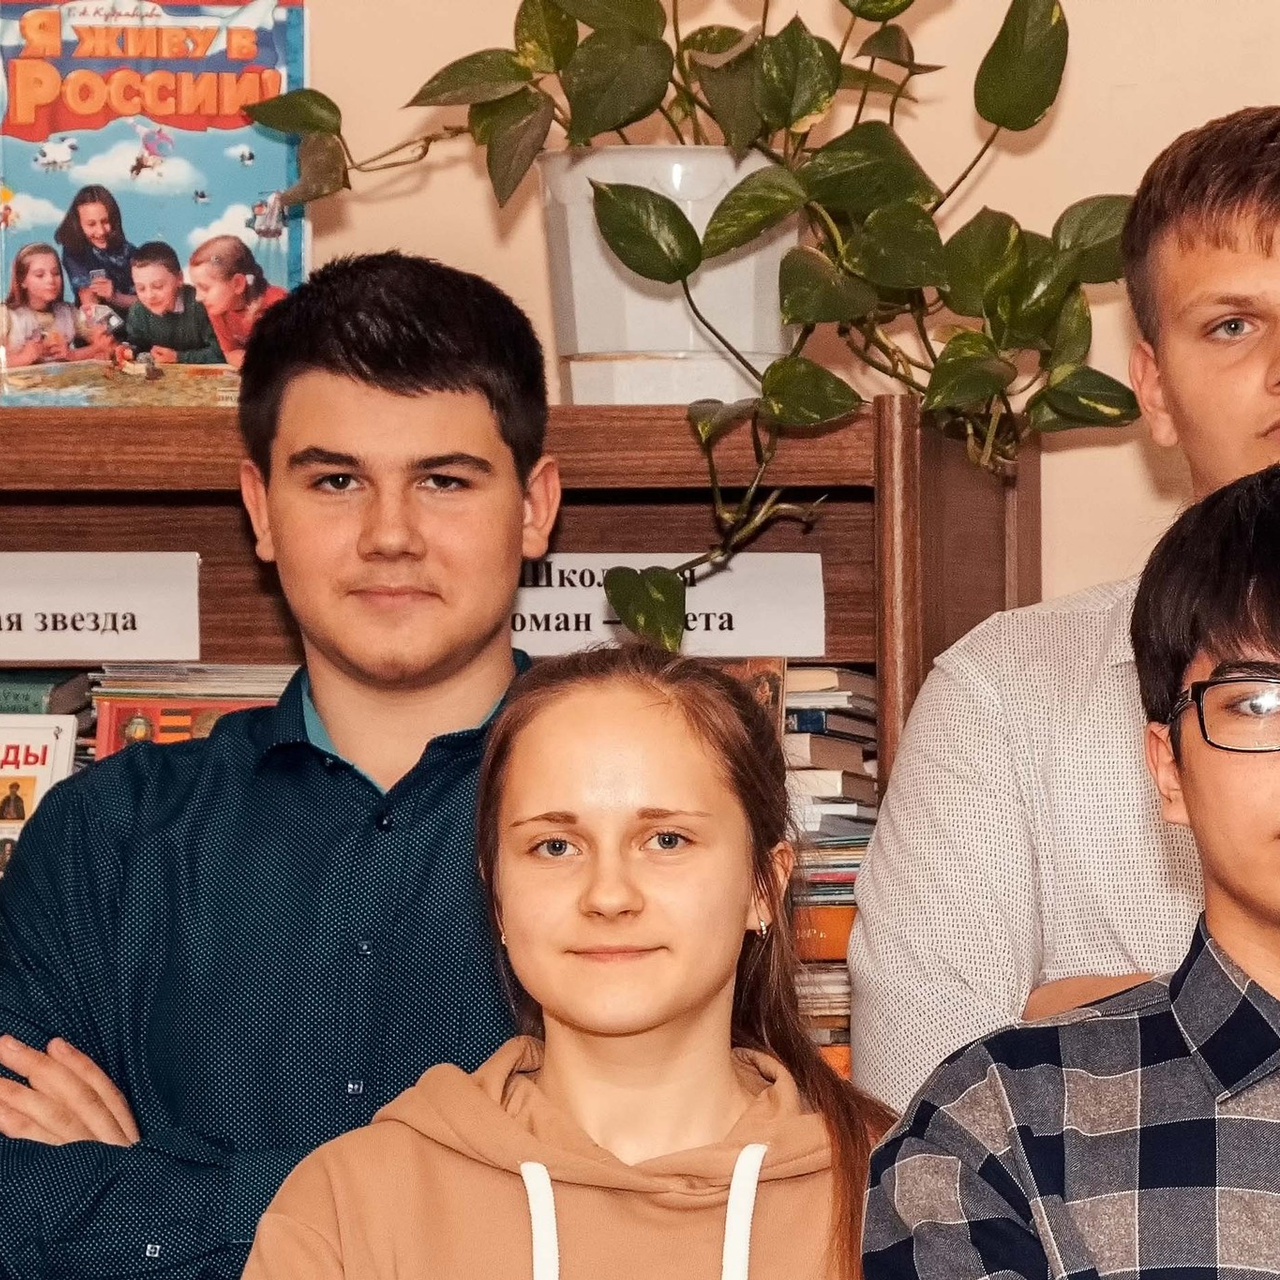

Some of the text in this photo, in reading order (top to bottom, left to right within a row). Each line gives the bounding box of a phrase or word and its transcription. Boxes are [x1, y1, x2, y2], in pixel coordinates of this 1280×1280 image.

[19, 8, 258, 60] Я ЖИВУ В
[519, 560, 697, 589] Шкоя
[34, 611, 138, 635] звезда
[510, 609, 735, 633] оман ета
[0, 744, 48, 770] ДЫ
